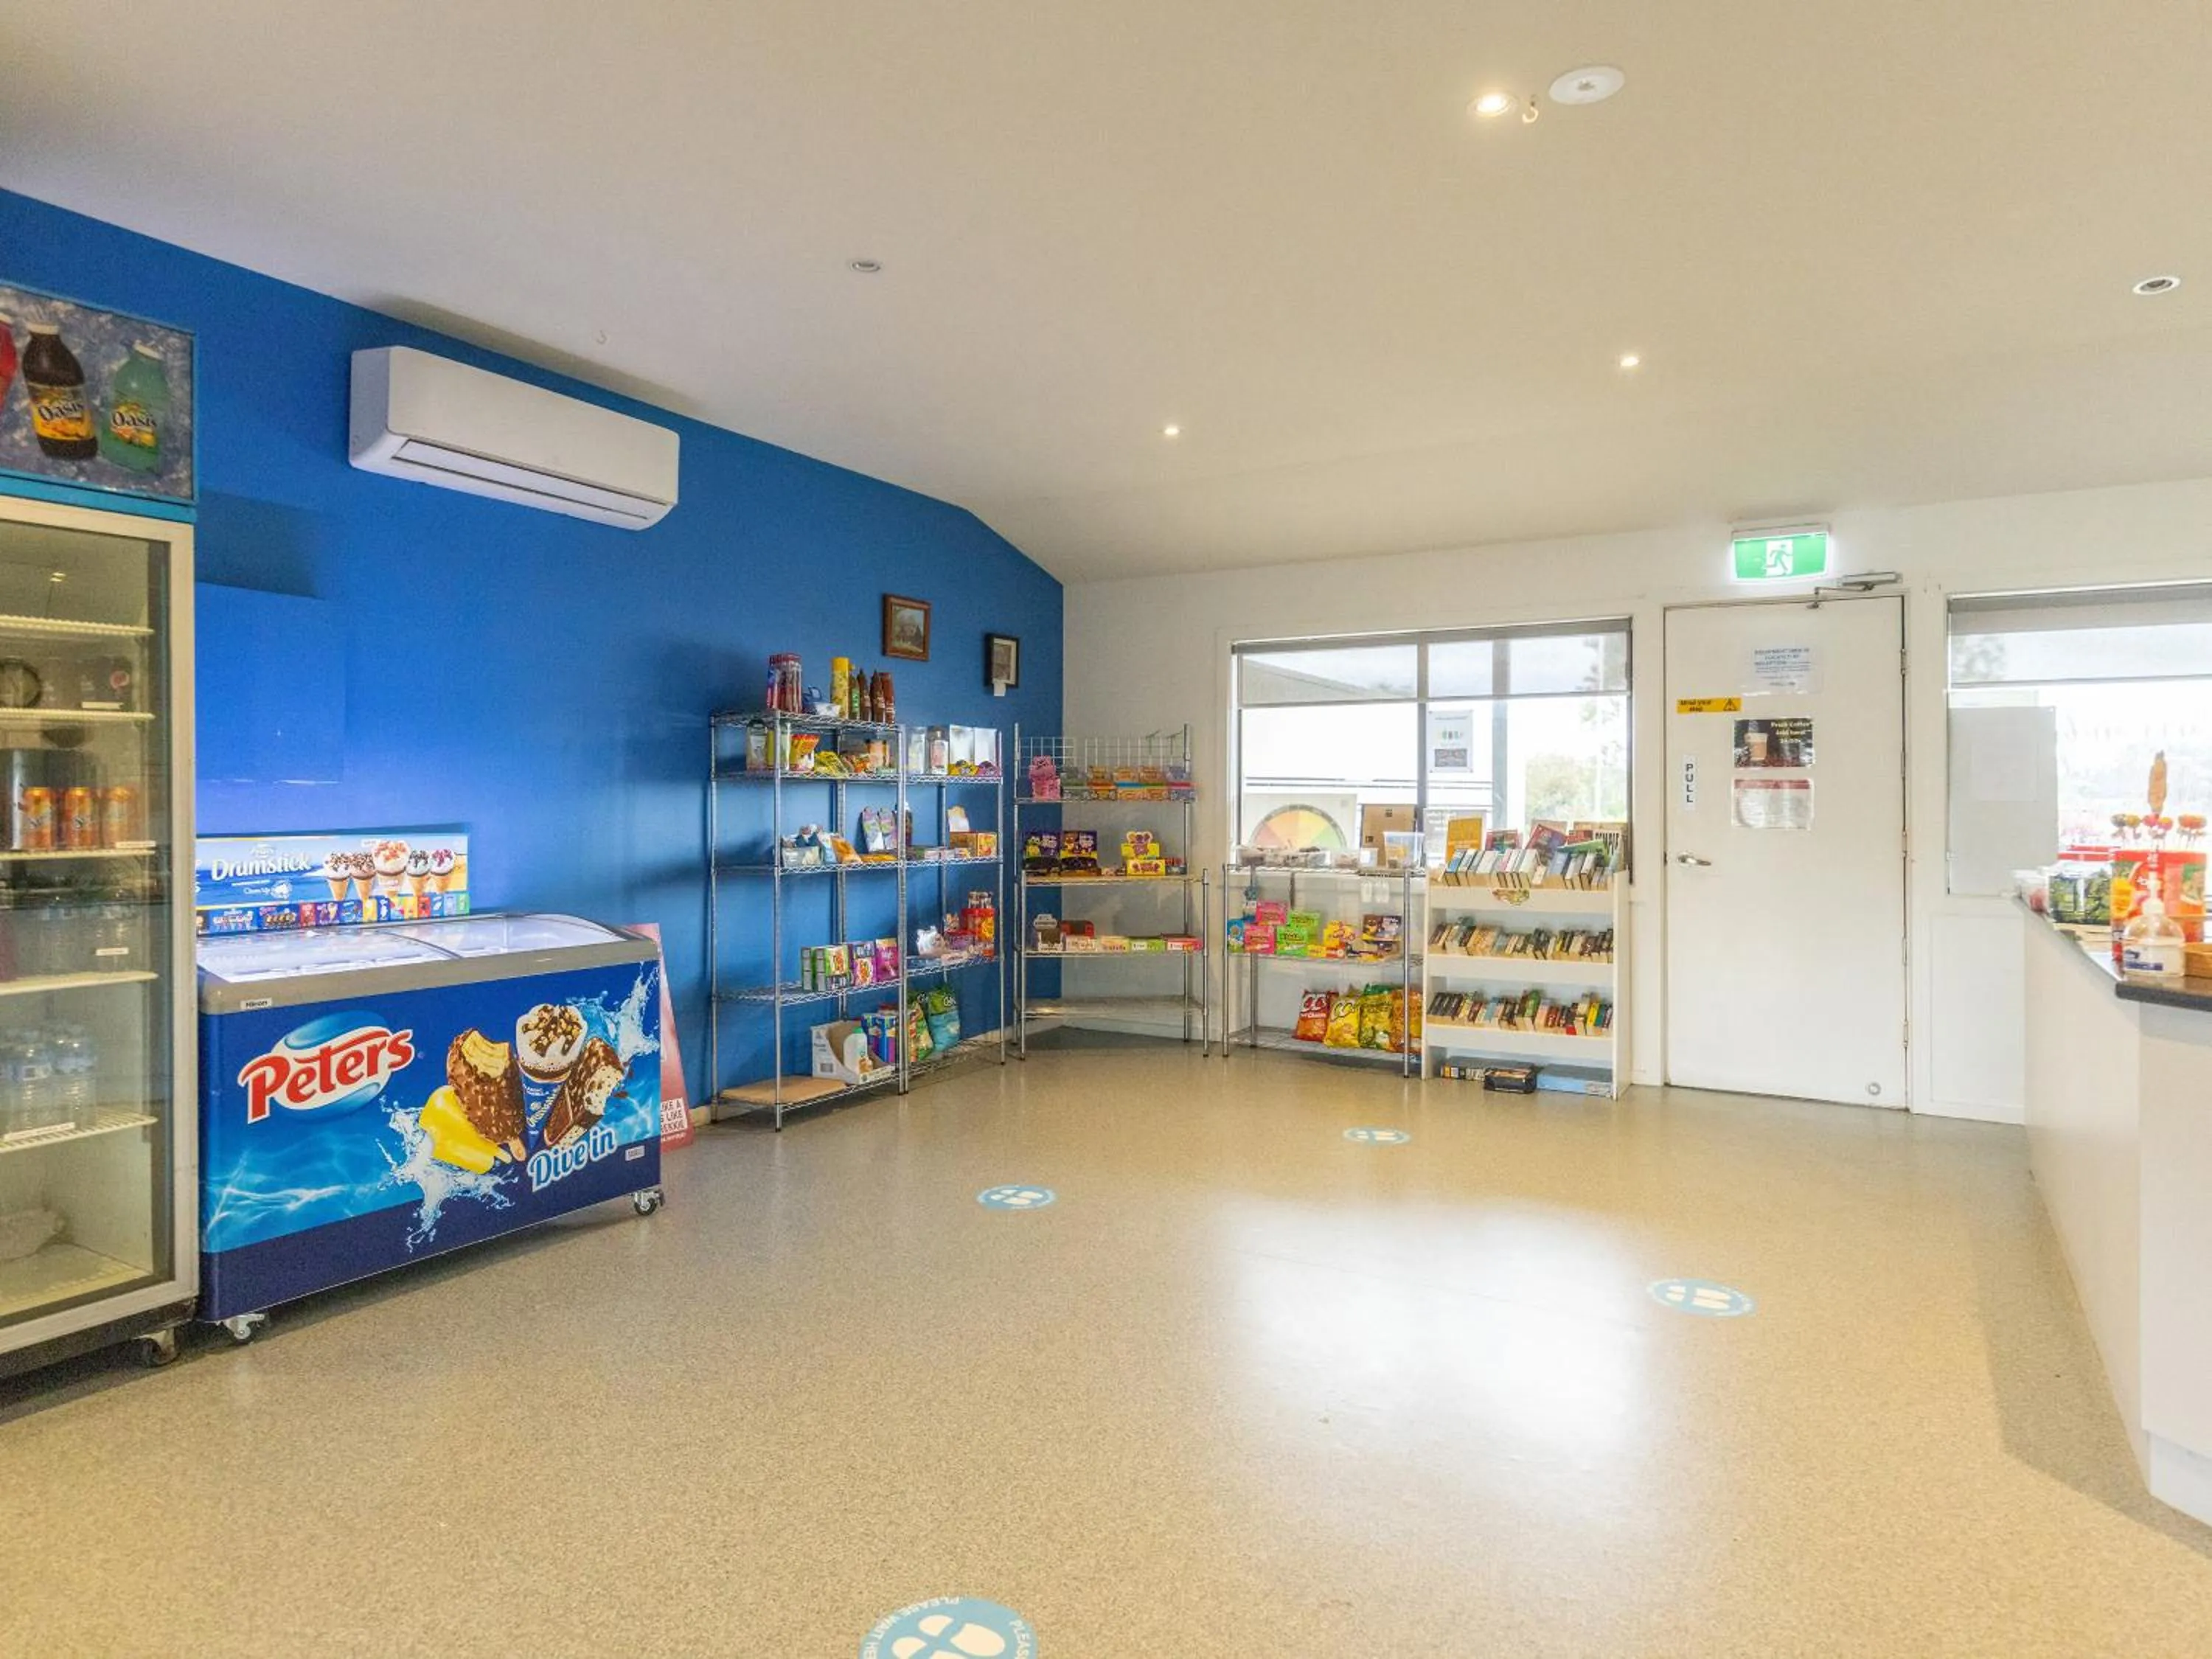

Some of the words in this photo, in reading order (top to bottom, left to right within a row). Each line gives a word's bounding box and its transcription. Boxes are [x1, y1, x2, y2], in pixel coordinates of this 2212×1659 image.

[38, 401, 84, 422] Oasis
[112, 411, 158, 428] Oasis
[1686, 764, 1694, 802] PULL
[211, 853, 312, 881] Drumstick
[240, 1029, 414, 1121] Peters
[526, 1140, 588, 1192] Dive
[589, 1126, 617, 1161] in
[863, 1641, 879, 1659] HE
